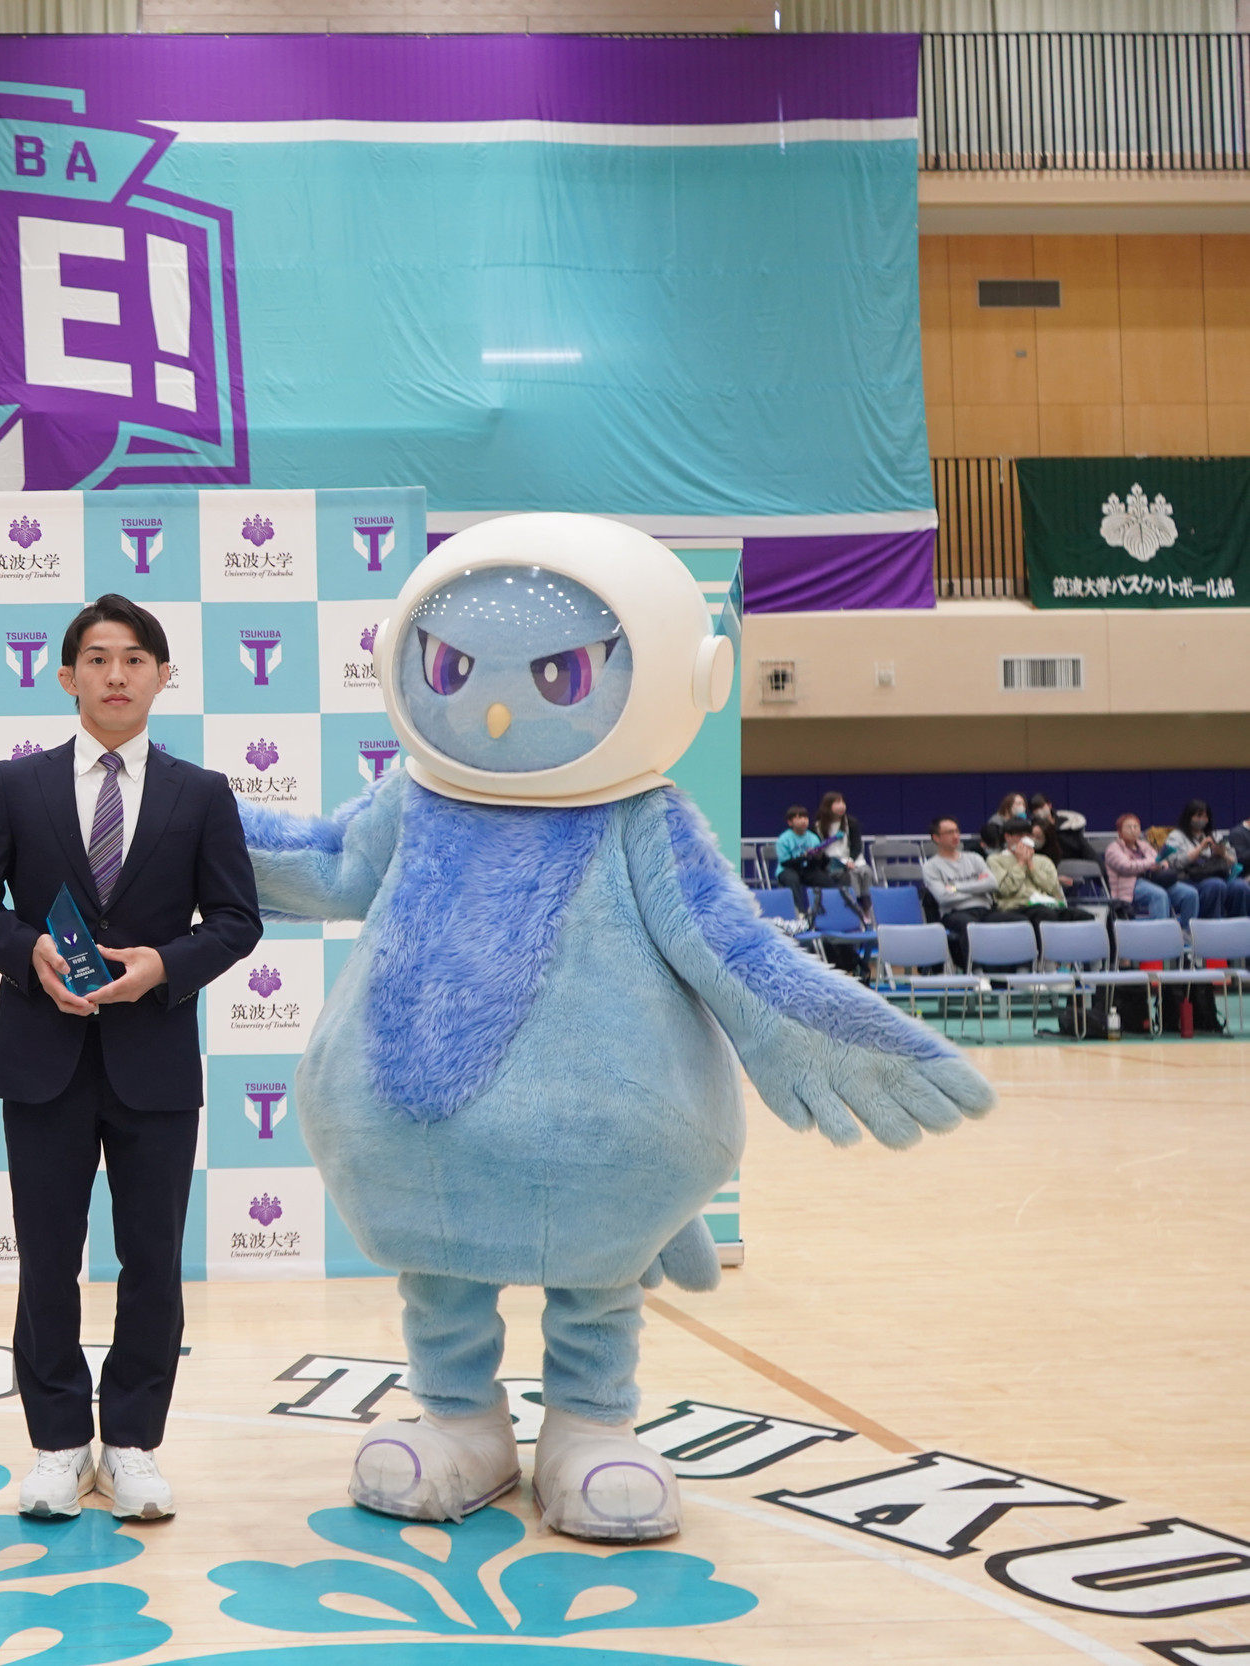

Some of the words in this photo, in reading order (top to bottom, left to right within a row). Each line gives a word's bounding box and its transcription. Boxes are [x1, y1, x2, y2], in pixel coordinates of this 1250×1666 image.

[121, 518, 163, 527] TSUKUBA
[353, 516, 395, 525] TSUKUBA
[224, 552, 293, 569] 筑波大学
[25, 571, 33, 580] of
[224, 569, 258, 578] University
[258, 569, 266, 578] of
[6, 631, 48, 640] TSUKUBA
[240, 630, 282, 638] TSUKUBA
[343, 680, 377, 689] University
[358, 740, 400, 749] TSUKUBA
[269, 793, 298, 801] Tsukuba
[231, 1003, 300, 1020] 筑波大学
[230, 1021, 264, 1030] University
[264, 1021, 272, 1030] of
[245, 1083, 287, 1091] TSUKUBA
[231, 1231, 300, 1249] 筑波大学
[230, 1250, 264, 1259] University
[264, 1250, 272, 1259] of
[272, 1249, 300, 1257] Tsukuba
